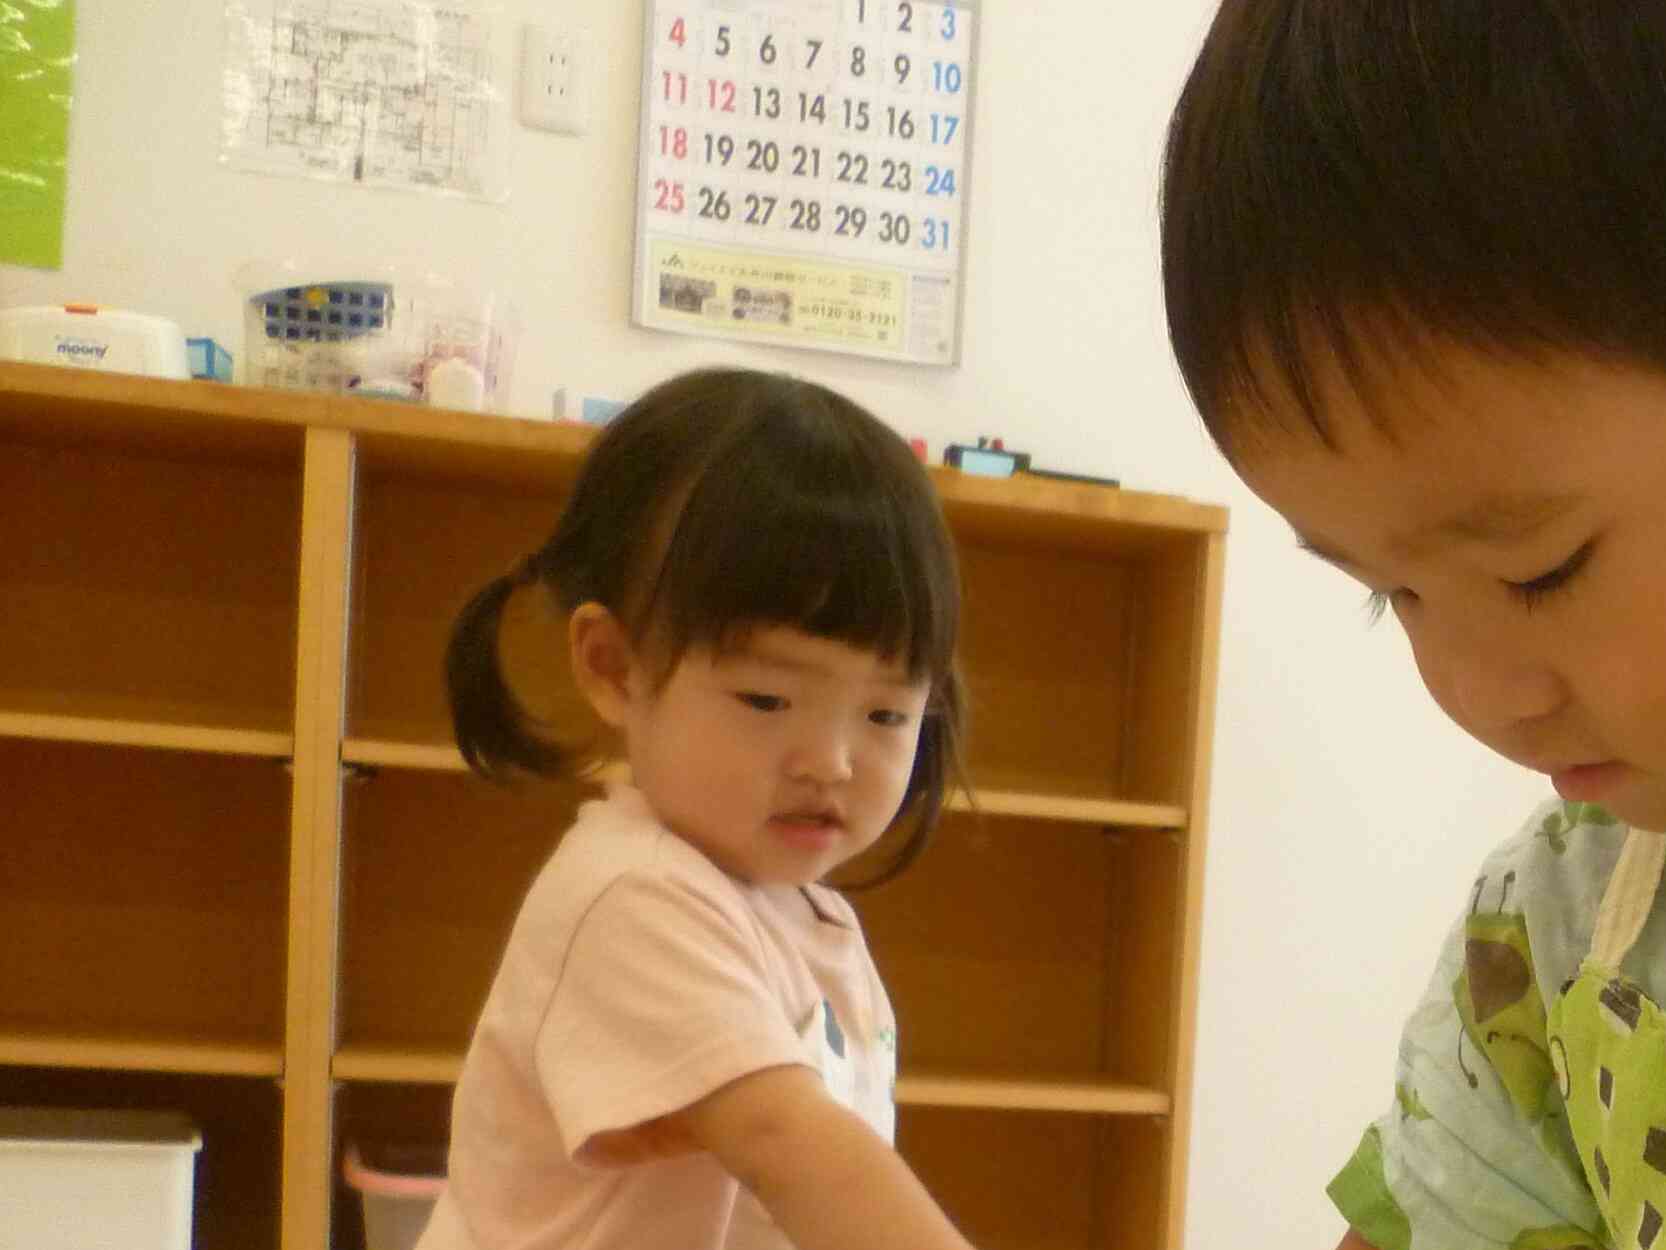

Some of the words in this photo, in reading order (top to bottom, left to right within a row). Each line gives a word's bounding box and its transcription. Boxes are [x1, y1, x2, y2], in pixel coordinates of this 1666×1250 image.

[669, 17, 686, 48] 4
[714, 25, 731, 57] 5
[759, 34, 777, 65] 6
[805, 39, 823, 70] 7
[850, 46, 866, 78] 8
[893, 54, 911, 85] 9
[933, 62, 962, 94] 10
[857, 0, 866, 24] 1
[897, 1, 913, 33] 2
[941, 9, 957, 41] 3
[662, 71, 688, 103] 11
[708, 80, 737, 113] 12
[752, 85, 781, 120] 13
[798, 92, 827, 125] 14
[843, 98, 870, 132] 15
[887, 106, 915, 140] 16
[930, 112, 960, 145] 17
[659, 126, 689, 160] 18
[704, 133, 735, 167] 19
[746, 139, 780, 174] 20
[791, 145, 821, 178] 21
[836, 152, 869, 185] 22
[880, 158, 912, 193] 23
[924, 165, 956, 197] 24
[653, 180, 685, 214] 25
[698, 186, 731, 222] 26
[744, 193, 778, 226] 27
[789, 199, 821, 233] 28
[834, 205, 867, 238] 29
[878, 211, 911, 245] 30
[920, 217, 951, 250] 31
[57, 342, 108, 359] moony
